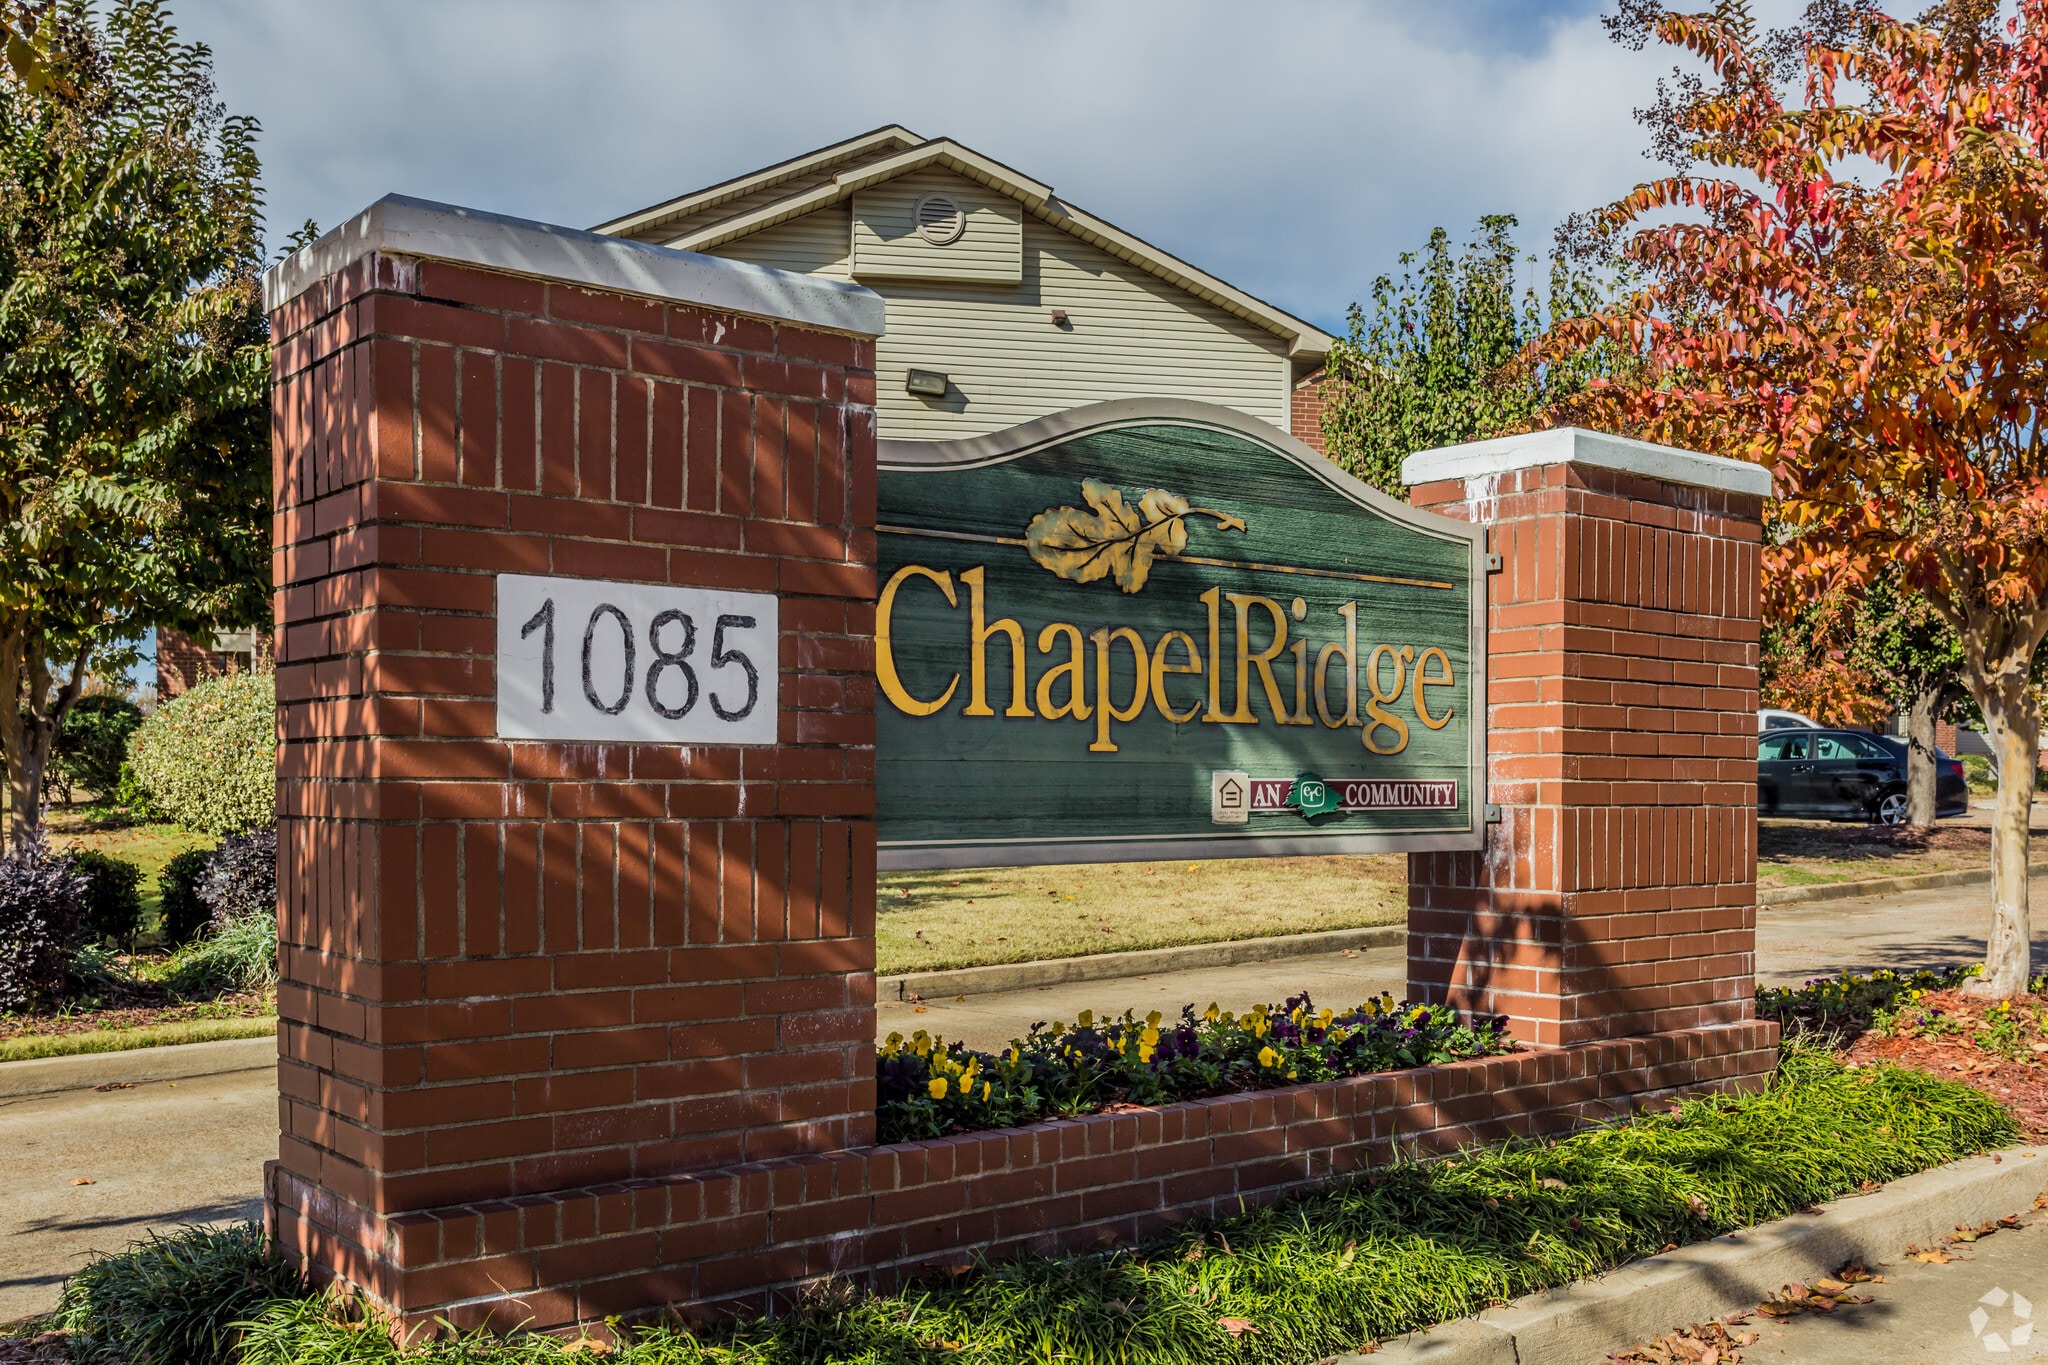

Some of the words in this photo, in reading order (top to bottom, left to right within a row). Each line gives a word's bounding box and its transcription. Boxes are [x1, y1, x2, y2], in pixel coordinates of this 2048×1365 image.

[520, 597, 759, 722] 1085
[876, 564, 1454, 755] ChapelRidge
[1253, 783, 1281, 807] AN
[1345, 784, 1453, 806] COMMUNITY
